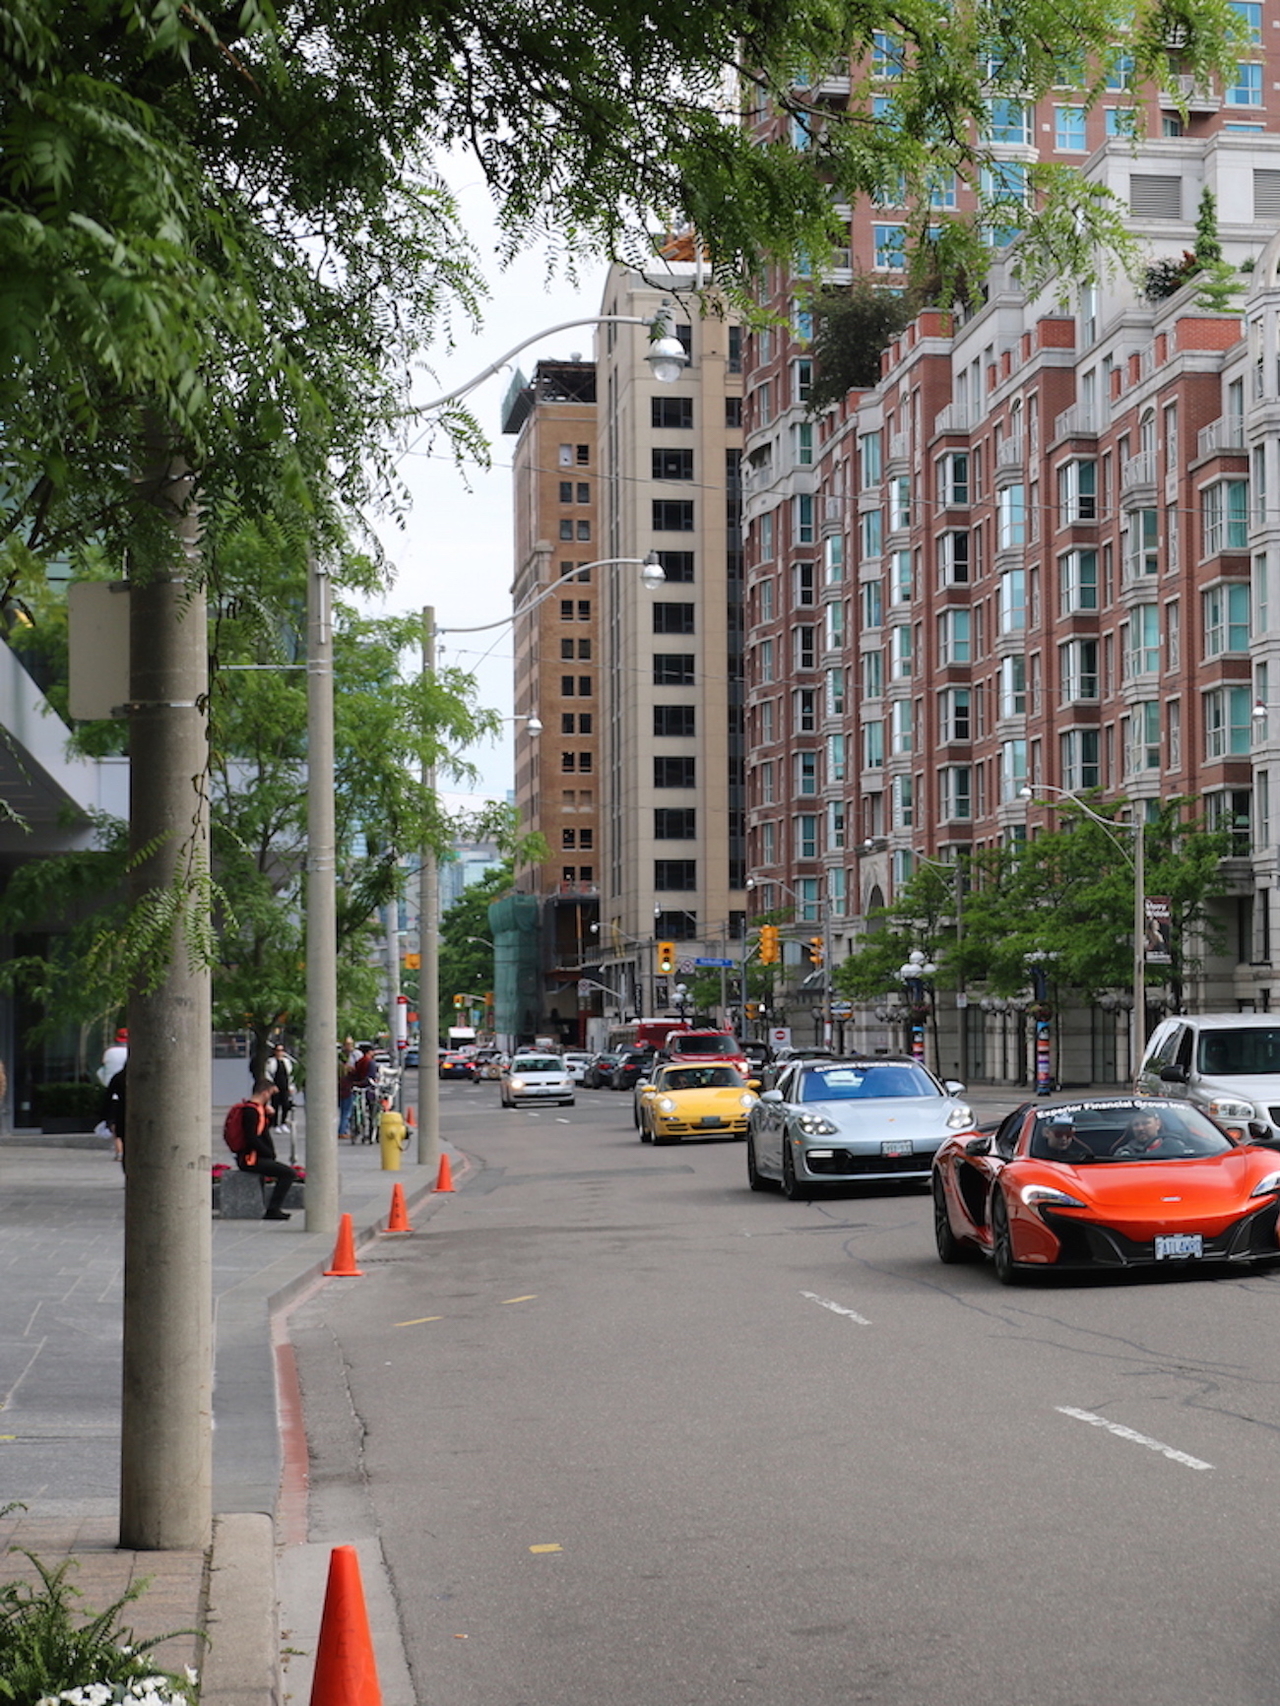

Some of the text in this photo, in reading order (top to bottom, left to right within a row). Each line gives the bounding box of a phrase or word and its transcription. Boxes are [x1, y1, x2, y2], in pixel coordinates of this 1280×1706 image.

[1083, 1100, 1133, 1111] Financial
[1133, 1099, 1168, 1110] Group
[1168, 1101, 1189, 1111] Inc.
